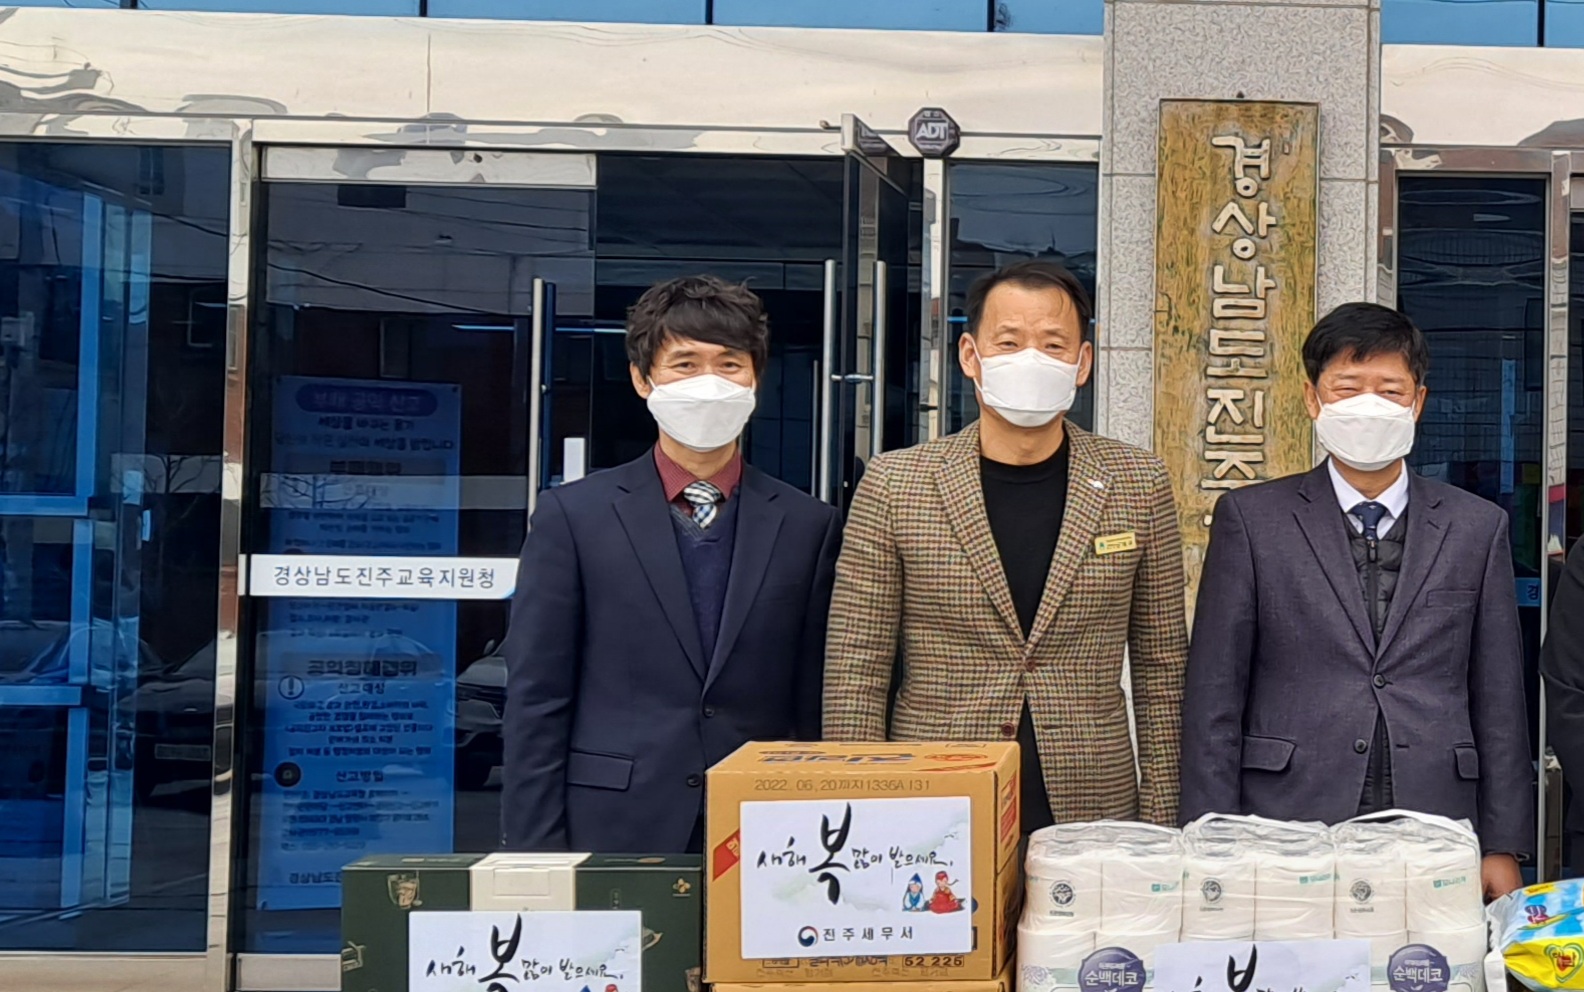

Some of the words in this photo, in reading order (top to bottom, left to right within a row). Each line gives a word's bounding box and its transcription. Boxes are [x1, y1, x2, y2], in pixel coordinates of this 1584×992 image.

[915, 122, 949, 140] ADT
[1200, 134, 1277, 526] 경상남도진주
[272, 564, 497, 590] 경상남도진주교육지원청
[756, 836, 806, 868] 새해
[808, 802, 851, 904] 복
[823, 925, 913, 942] 진주세무서
[425, 945, 475, 976] 새해
[1084, 969, 1139, 988] 순백데코
[1392, 967, 1443, 984] 순백데코
